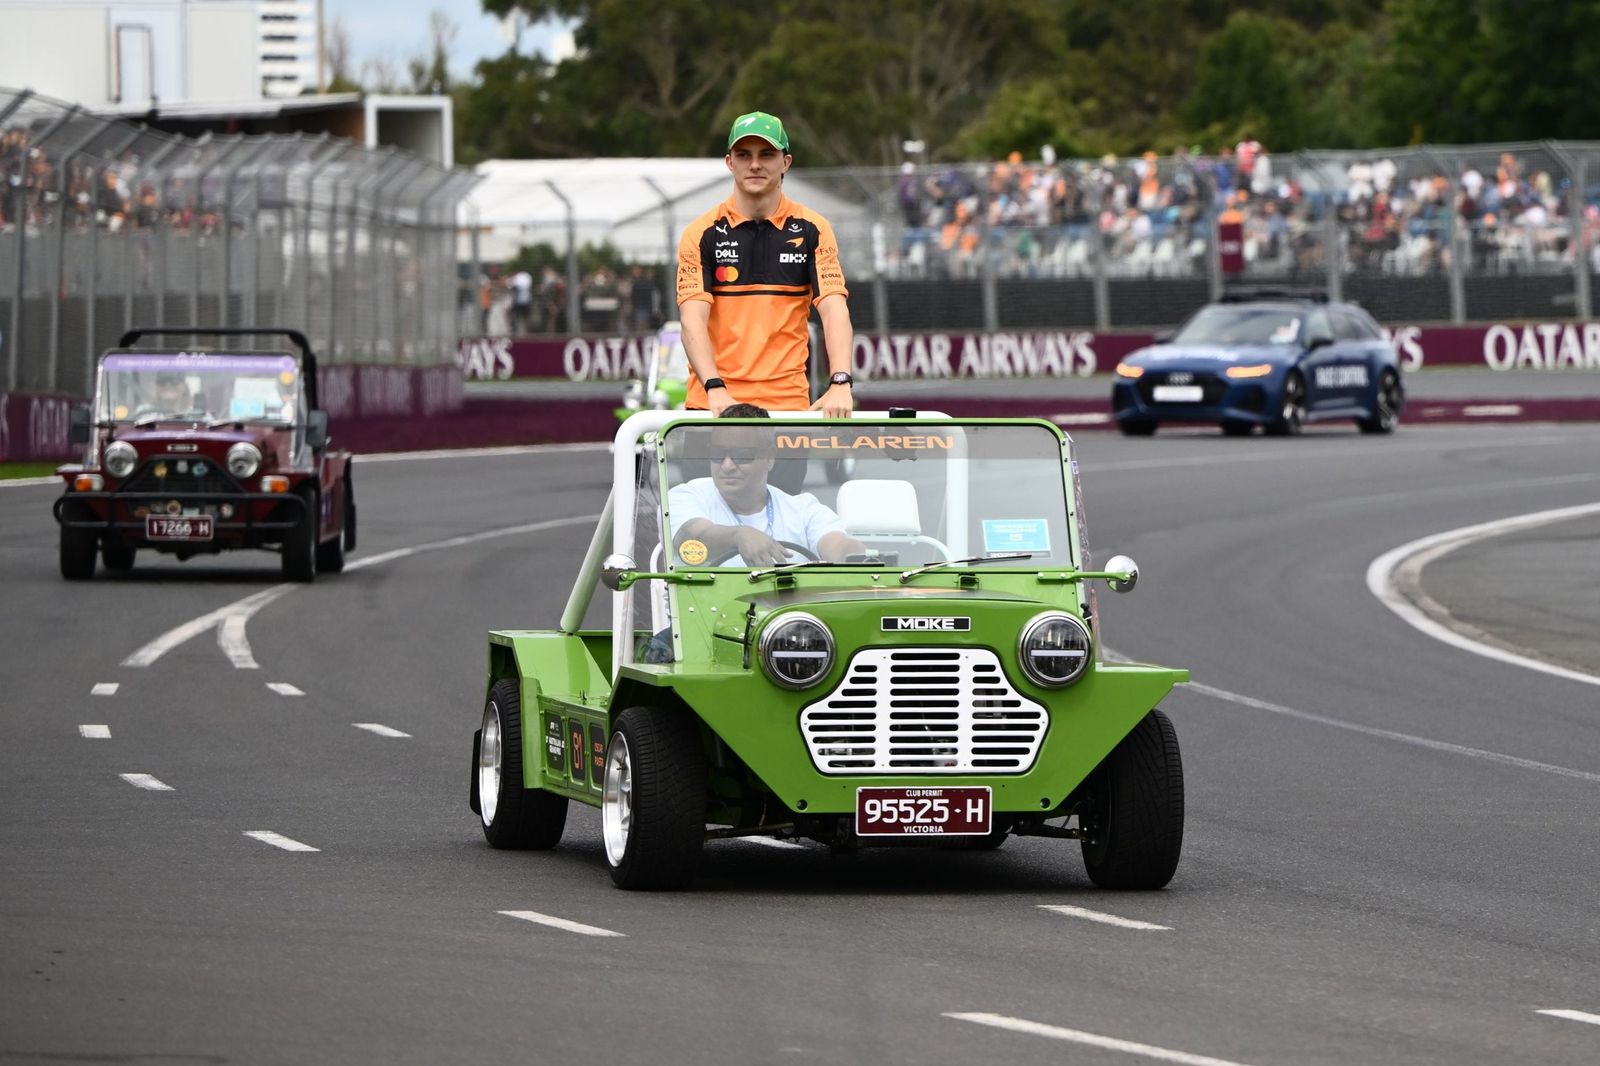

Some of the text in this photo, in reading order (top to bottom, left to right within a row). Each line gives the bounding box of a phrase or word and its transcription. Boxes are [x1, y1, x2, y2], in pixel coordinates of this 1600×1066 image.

[715, 249, 739, 259] DELL
[779, 253, 807, 264] OKX
[852, 332, 1097, 380] QATAR AIRWAYS
[897, 618, 955, 630] MOKE
[905, 789, 943, 797] CLUB PERMIT
